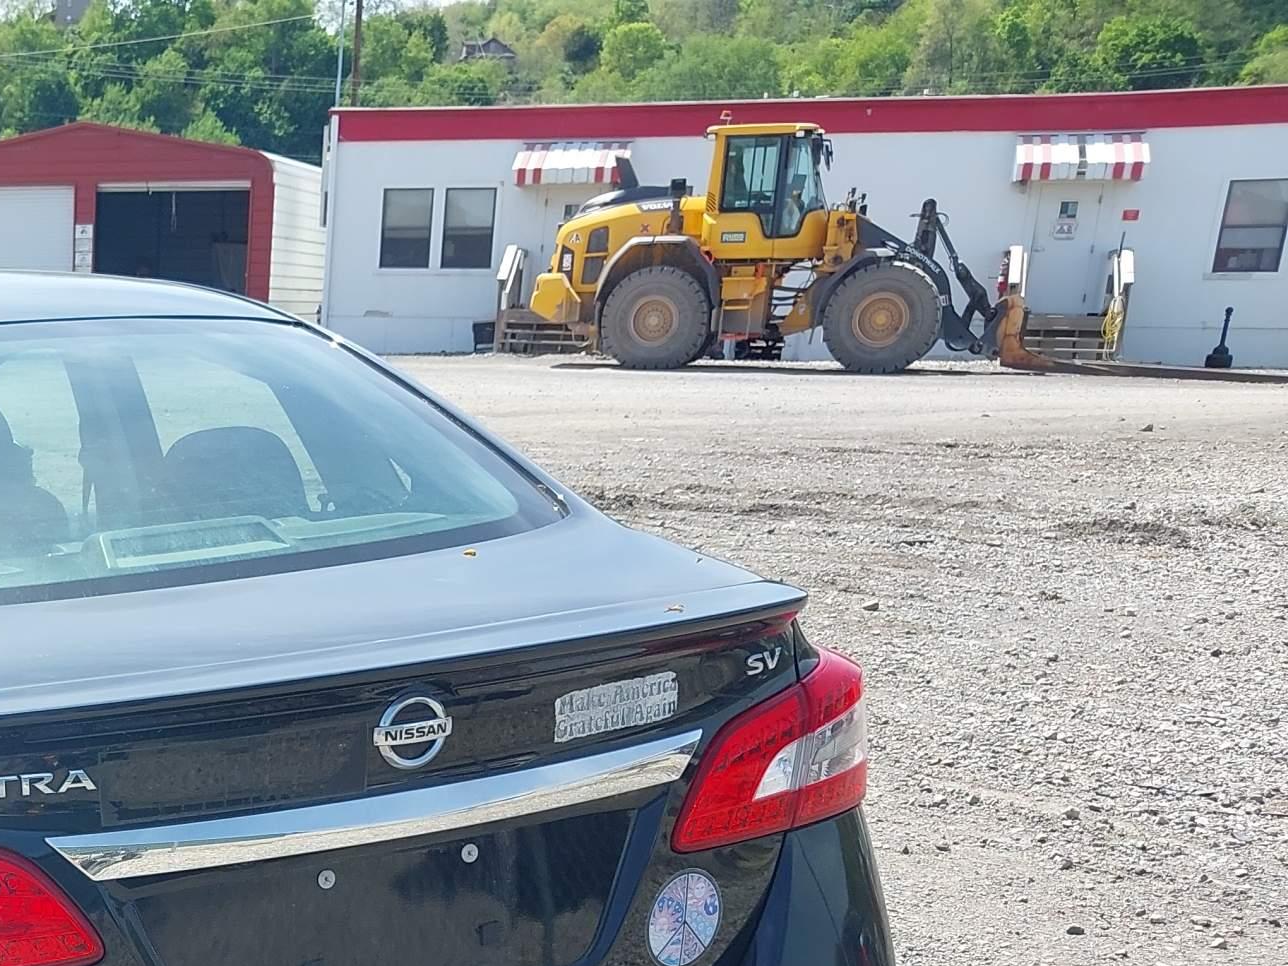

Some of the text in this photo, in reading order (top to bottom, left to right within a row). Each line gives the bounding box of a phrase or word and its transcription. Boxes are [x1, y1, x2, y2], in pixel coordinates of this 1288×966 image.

[745, 647, 782, 676] SV
[558, 679, 678, 715] Make America
[384, 721, 447, 742] NISSAN
[556, 698, 676, 739] Grateful Again
